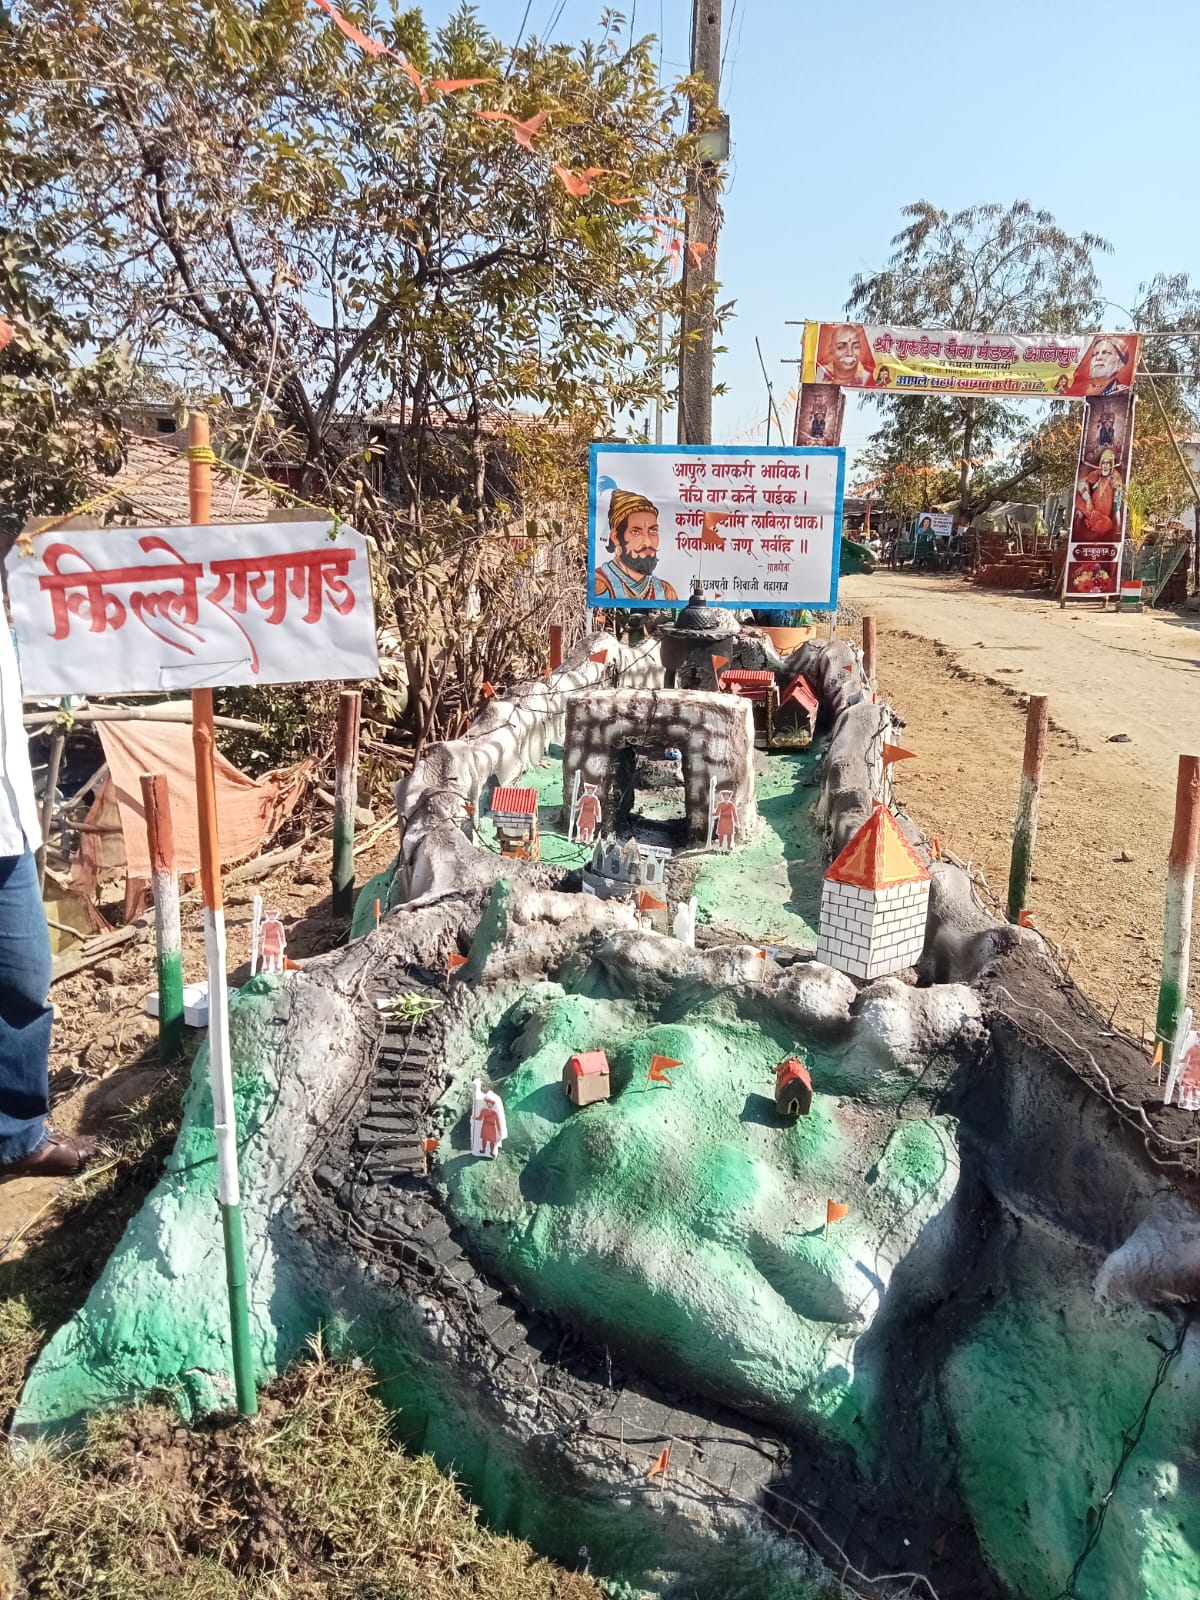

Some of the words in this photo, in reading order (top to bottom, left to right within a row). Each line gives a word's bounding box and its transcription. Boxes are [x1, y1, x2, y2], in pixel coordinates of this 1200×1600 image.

[873, 333, 893, 353] श्री
[896, 336, 941, 360] गुरुदेव
[944, 338, 975, 359] सेवा
[673, 458, 707, 483] आपुले
[712, 459, 756, 479] वारकरी
[761, 460, 801, 479] भाविक
[679, 484, 703, 504] तेचि
[707, 489, 728, 504] वार
[731, 485, 758, 504] कर्ते
[762, 485, 797, 505] पाईक
[752, 511, 791, 530] लाविला
[731, 538, 754, 556] जणू
[733, 576, 759, 591] शिवाजी
[763, 580, 789, 593] महाराज
[39, 536, 205, 656] किल्ले
[205, 547, 357, 675] रायगड
